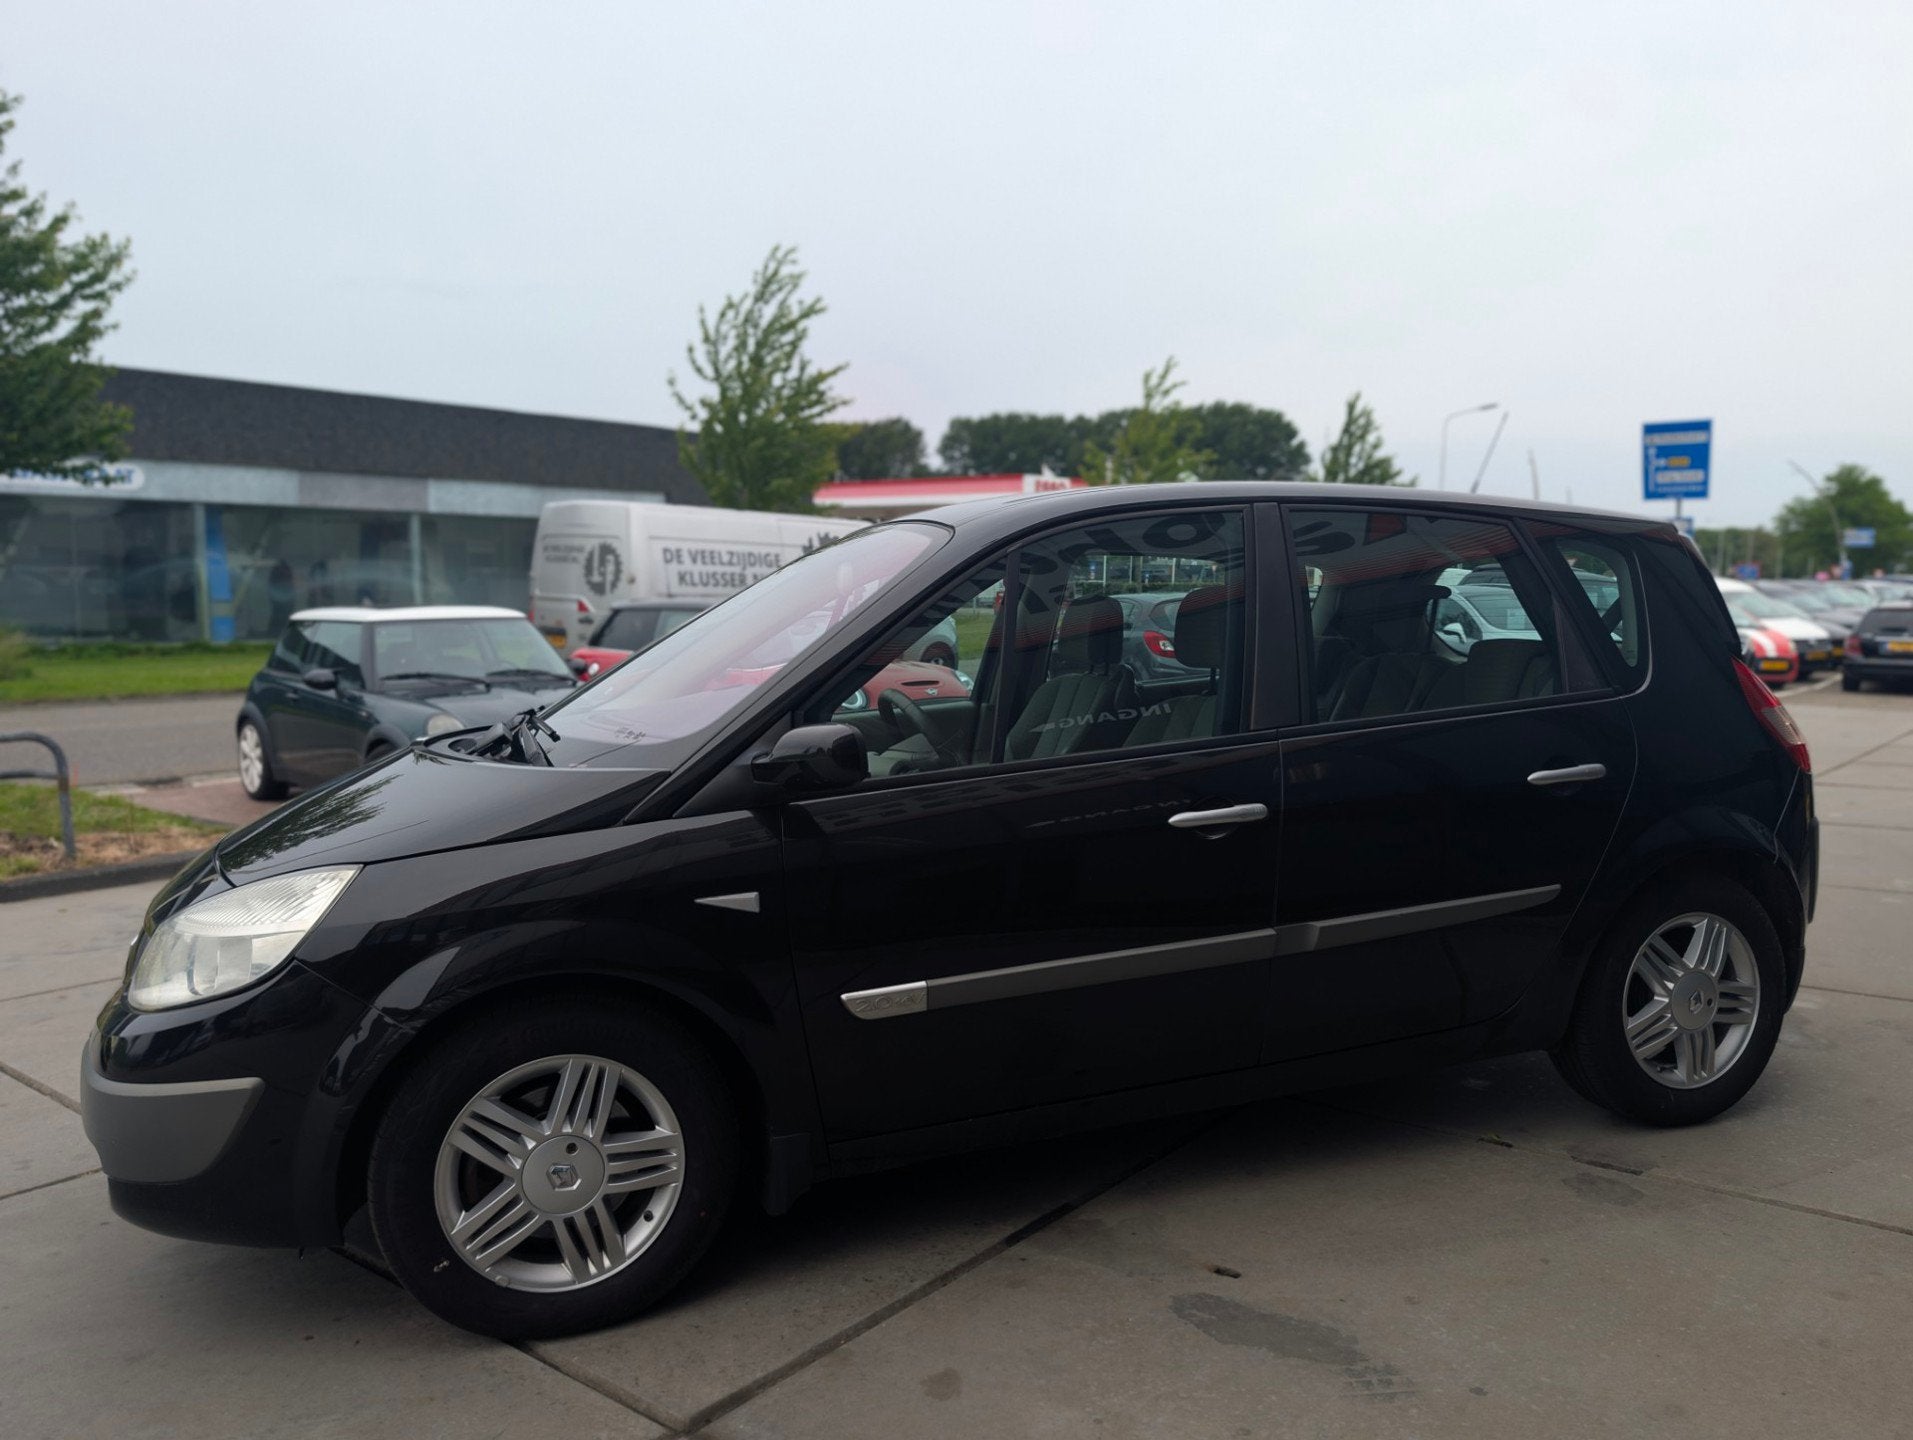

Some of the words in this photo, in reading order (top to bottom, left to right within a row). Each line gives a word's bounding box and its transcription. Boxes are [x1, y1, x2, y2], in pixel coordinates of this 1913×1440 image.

[662, 547, 684, 564] DE
[688, 549, 780, 571] VEELZIJDIGE
[677, 570, 747, 587] KLUSSER
